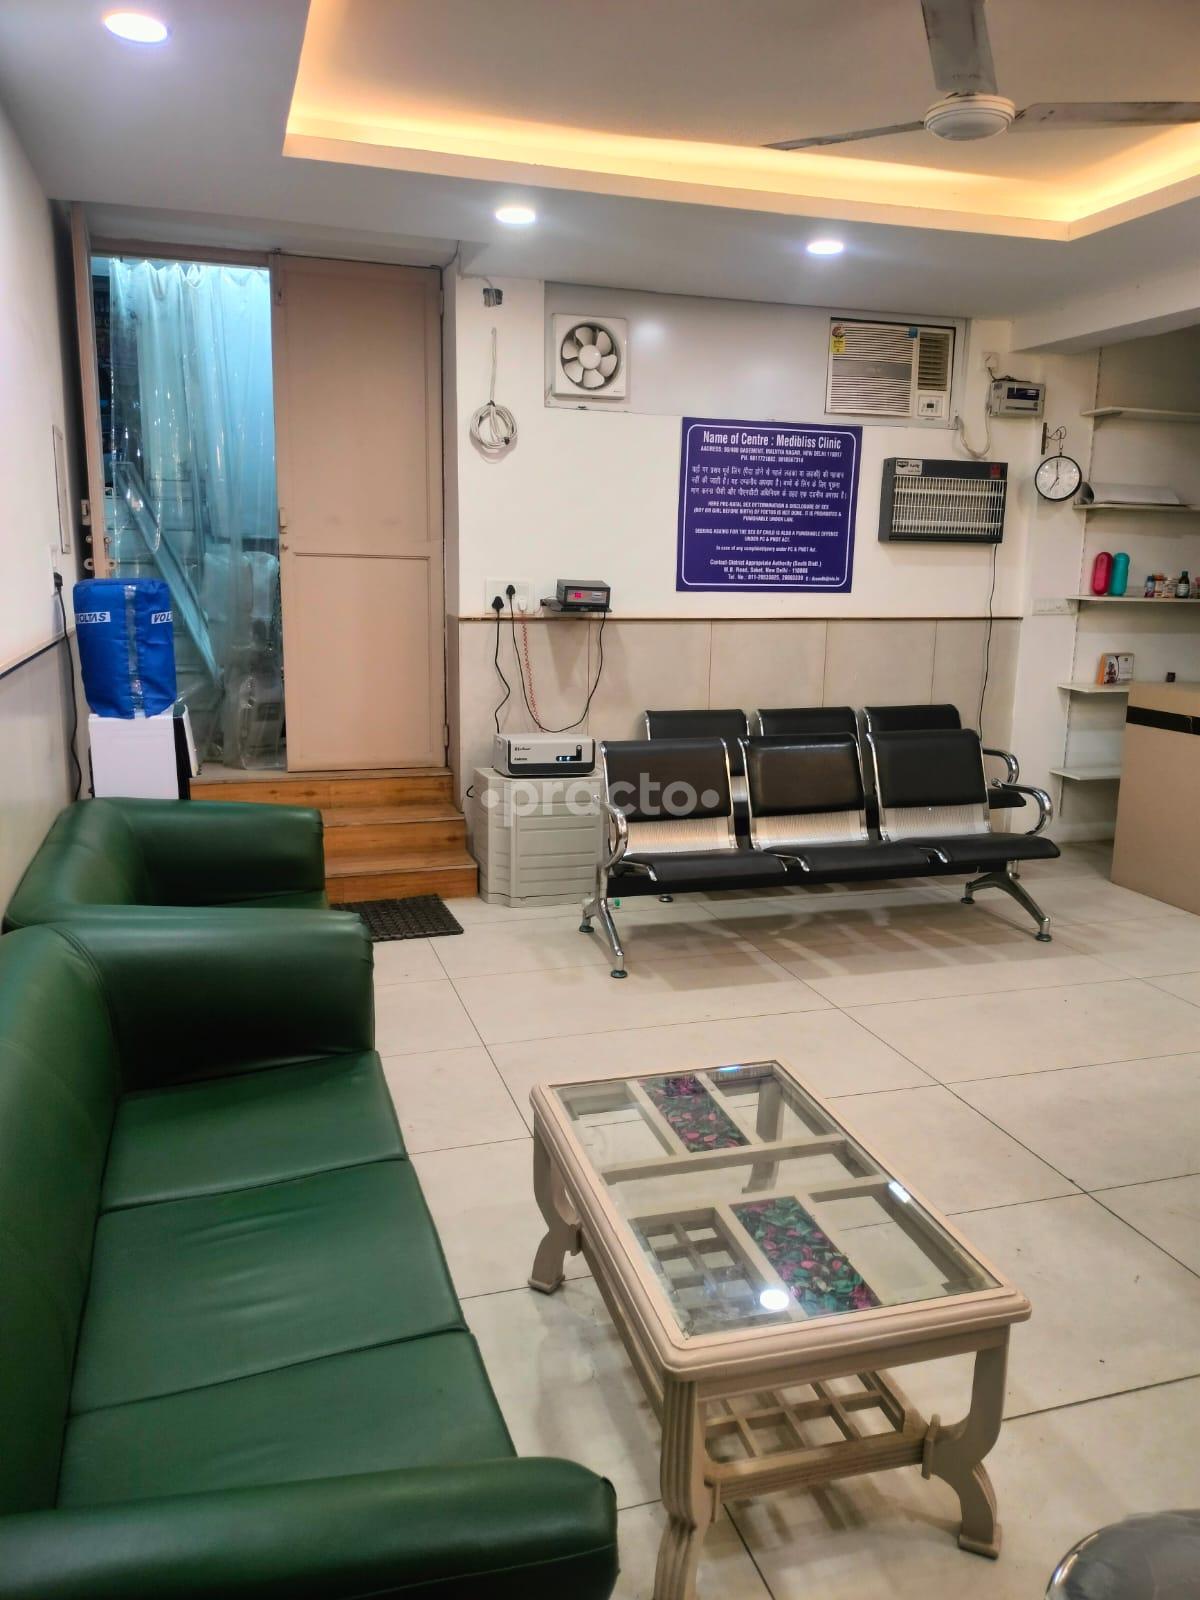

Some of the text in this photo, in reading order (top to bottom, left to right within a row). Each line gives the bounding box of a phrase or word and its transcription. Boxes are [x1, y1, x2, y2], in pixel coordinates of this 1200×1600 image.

[704, 431, 728, 444] Name
[730, 433, 739, 444] of
[742, 433, 768, 446] Centre
[776, 434, 816, 448] Medibliss
[818, 436, 842, 449] Clinic
[77, 612, 106, 622] OLTAS
